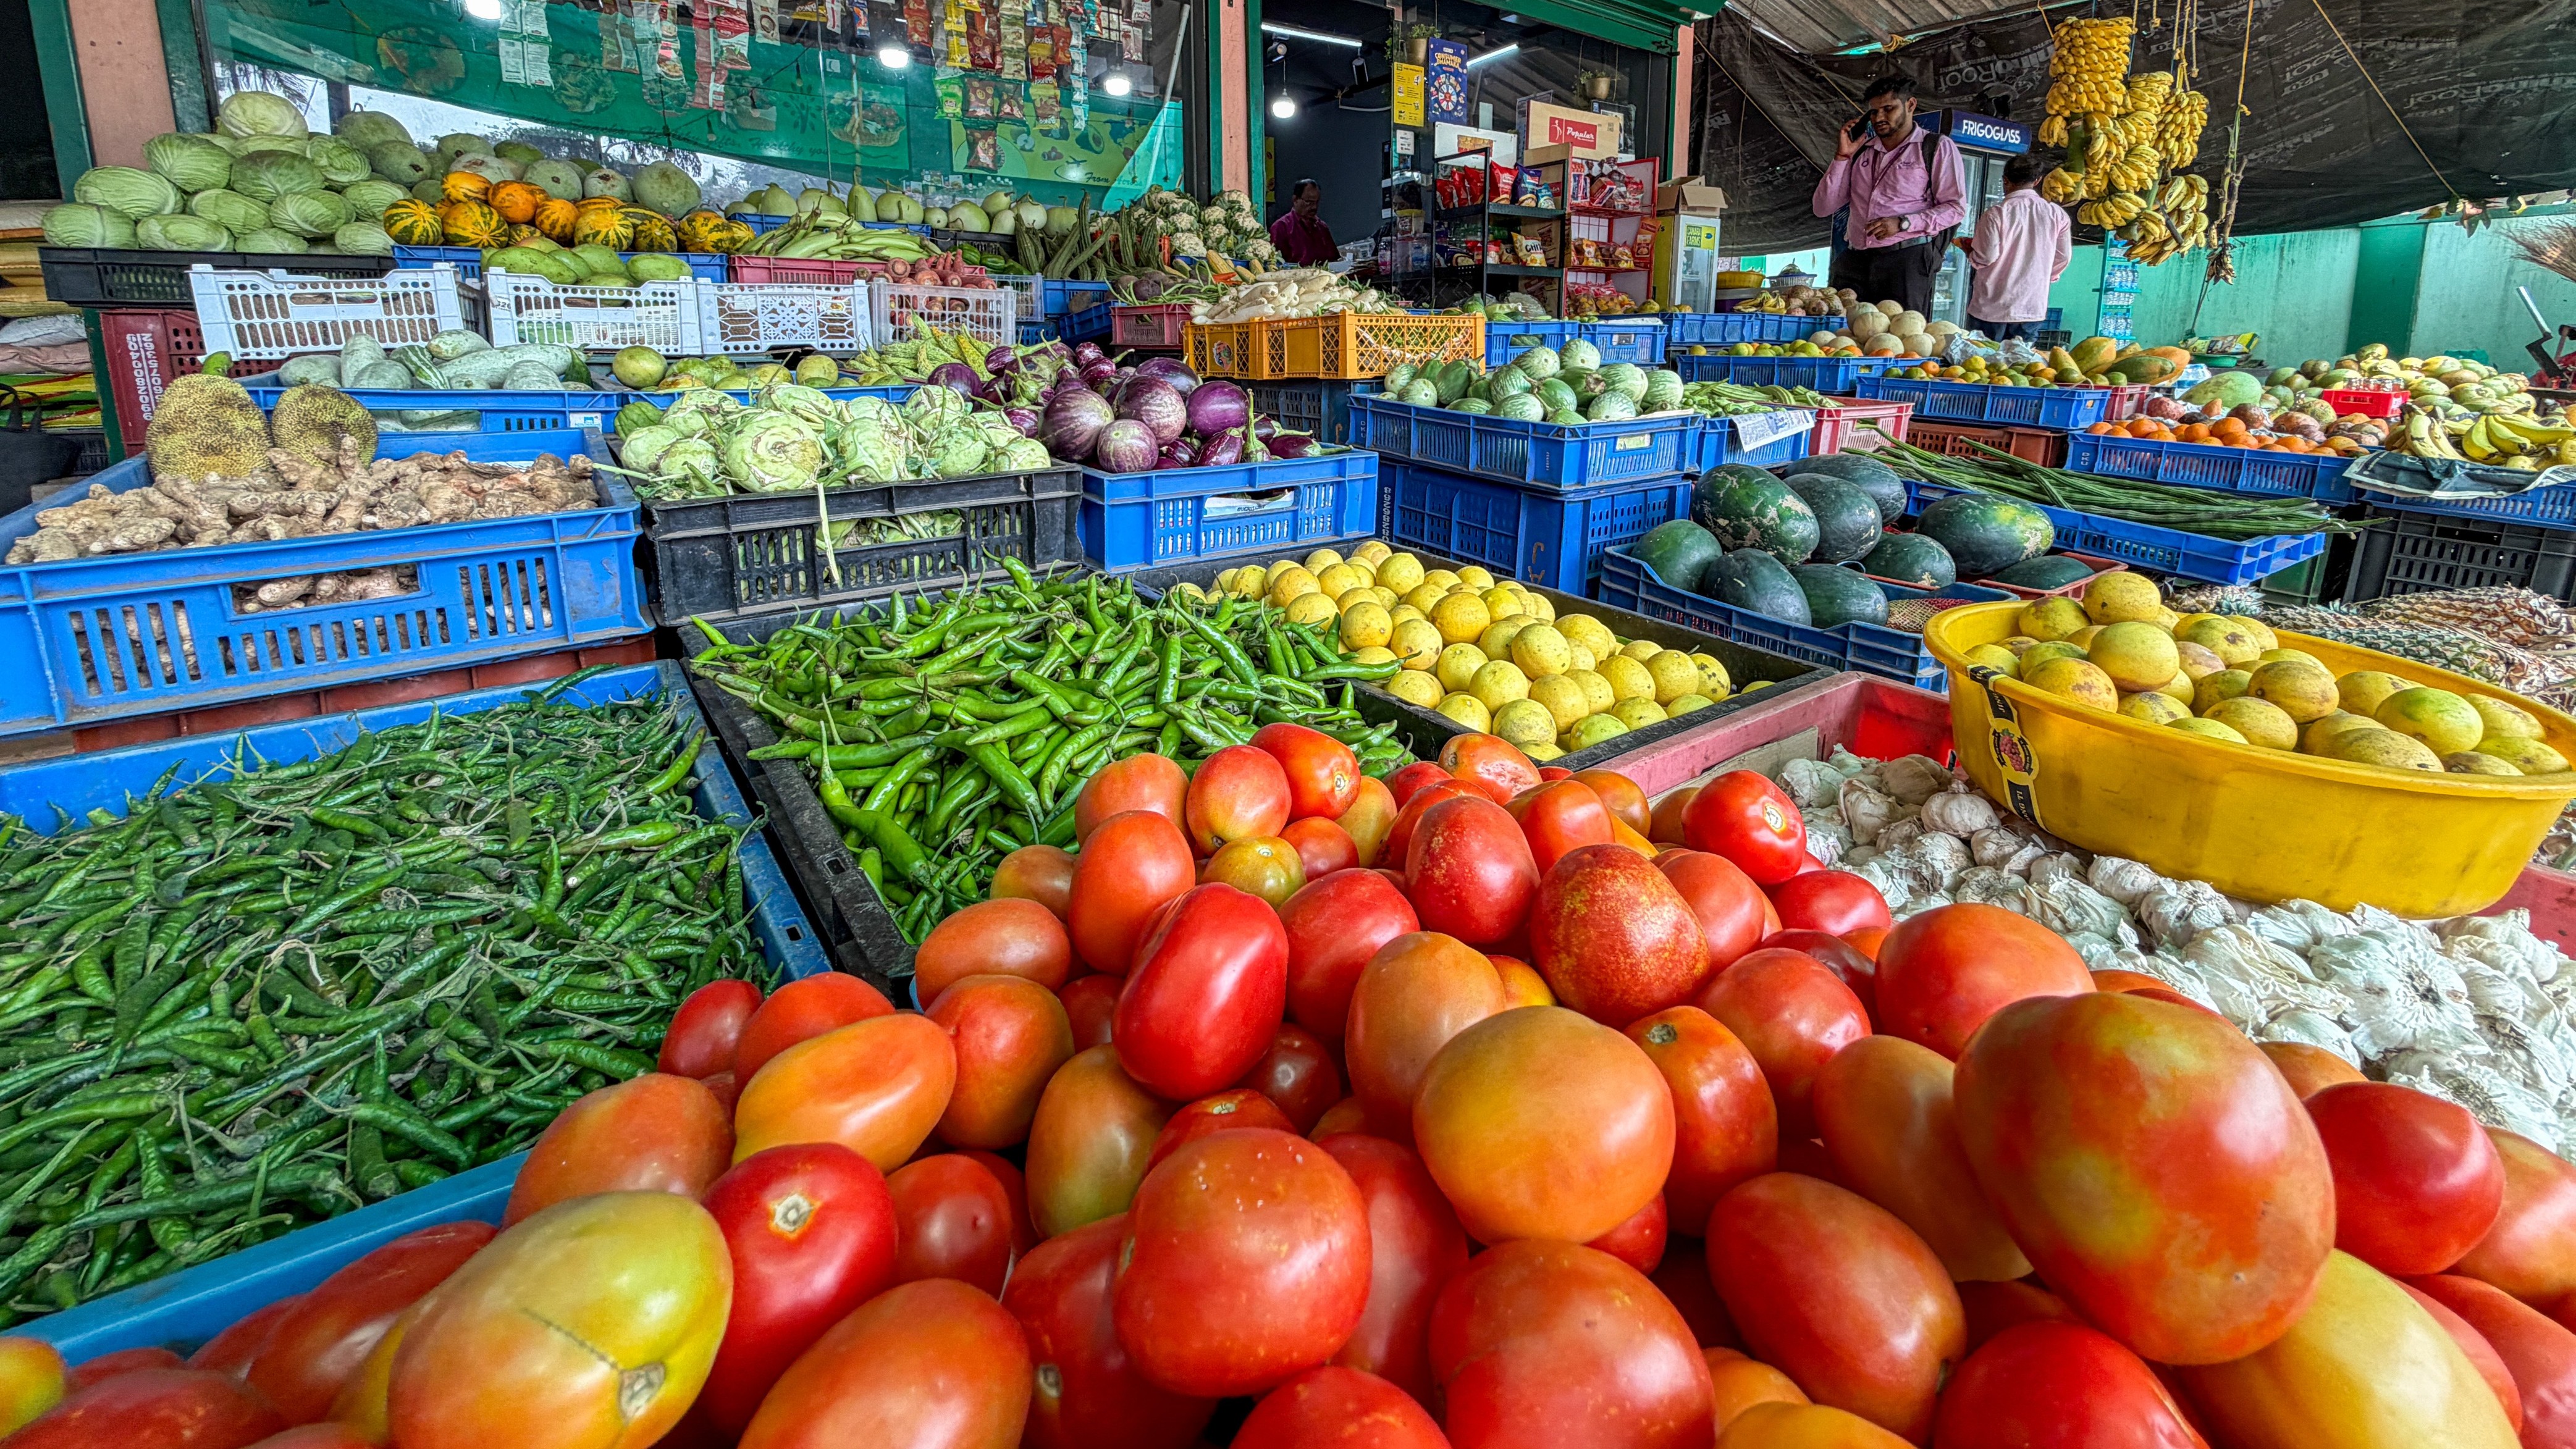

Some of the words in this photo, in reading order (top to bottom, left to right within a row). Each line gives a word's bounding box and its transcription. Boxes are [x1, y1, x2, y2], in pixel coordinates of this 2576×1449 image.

[1566, 126, 1595, 140] Popular
[1961, 119, 2021, 145] FRIGOGLASS
[1085, 172, 1111, 183] From
